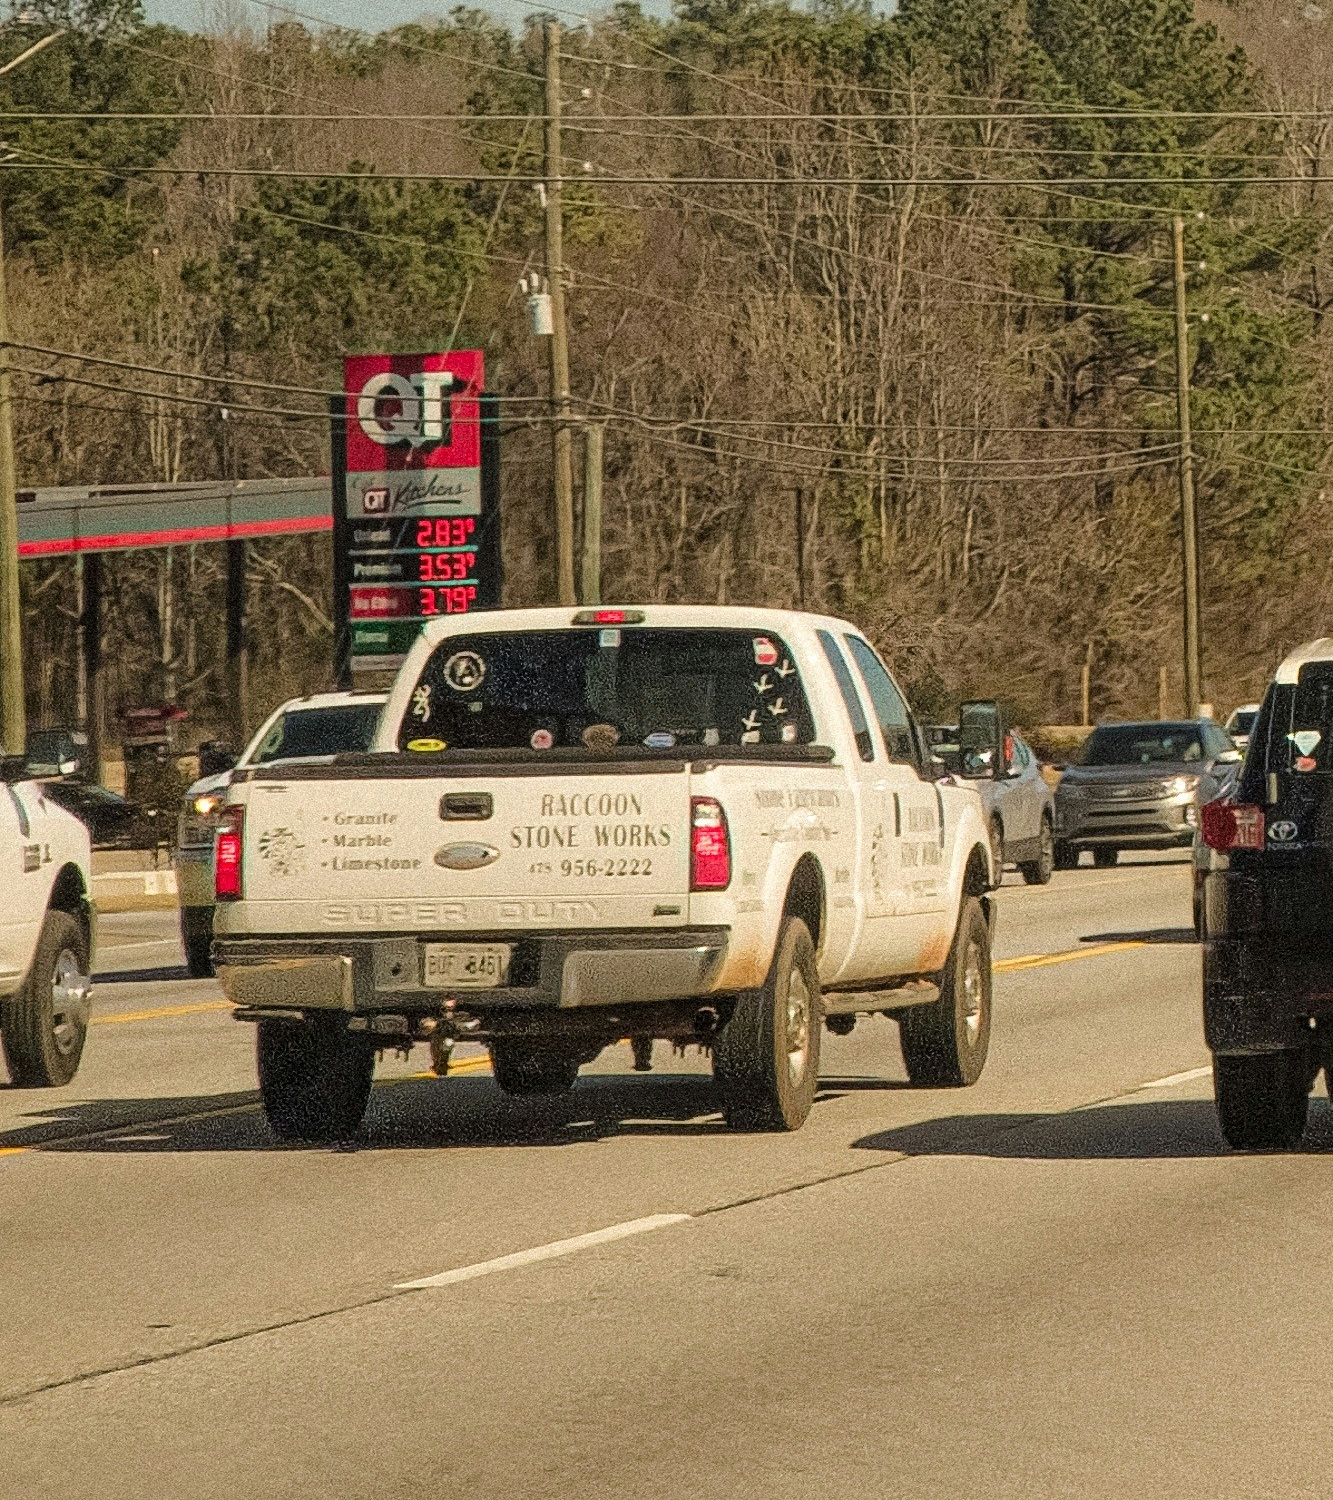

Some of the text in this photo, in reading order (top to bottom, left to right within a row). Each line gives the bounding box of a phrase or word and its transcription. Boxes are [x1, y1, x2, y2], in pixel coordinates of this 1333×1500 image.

[357, 371, 454, 447] QT
[541, 793, 643, 817] RACCOON
[334, 812, 398, 825] Granite
[333, 834, 392, 847] Marble
[510, 823, 671, 849] STONE WORKS
[331, 855, 422, 871] Limestone
[560, 858, 653, 877] 956-2222
[320, 900, 605, 925] SUPER DUTY
